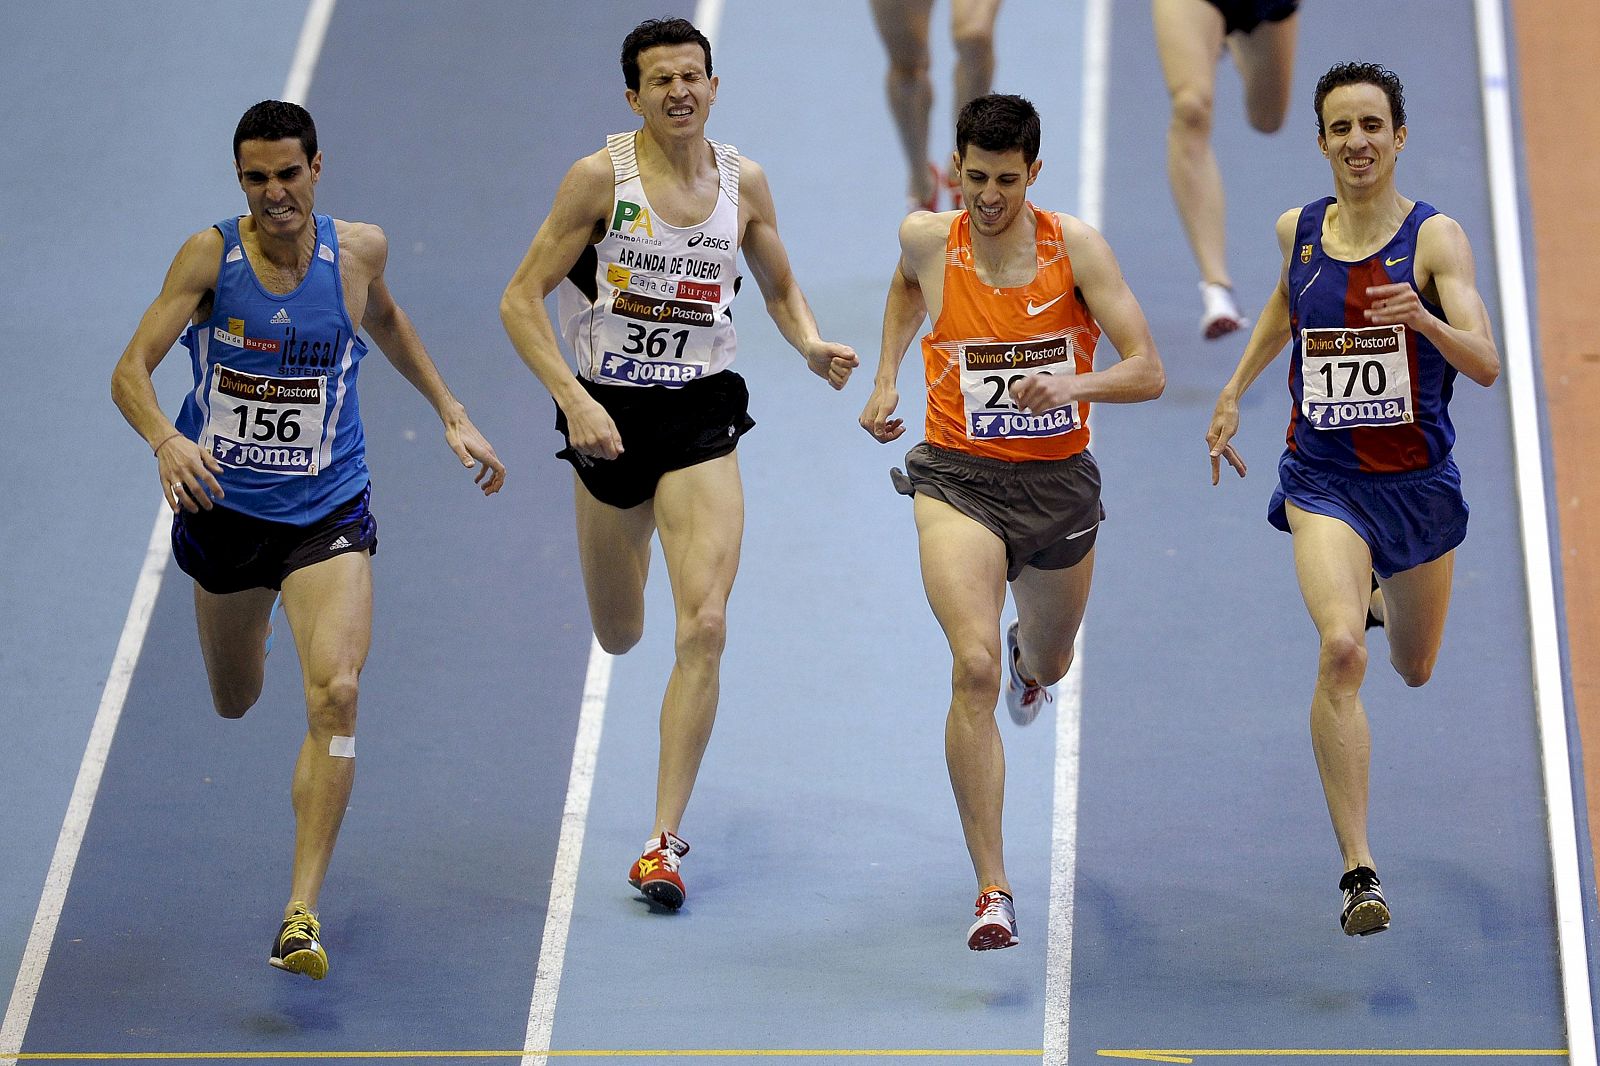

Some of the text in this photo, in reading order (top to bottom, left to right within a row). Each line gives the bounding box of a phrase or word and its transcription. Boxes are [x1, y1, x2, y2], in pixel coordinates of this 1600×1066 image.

[612, 200, 653, 238] PA
[609, 231, 662, 246] PromoAranda
[703, 236, 730, 250] asics
[619, 248, 721, 280] ARANDA DE DUERO
[630, 275, 719, 300] Caja de Burgos
[615, 297, 713, 321] Divina Pastora
[216, 330, 277, 351] Caja de Burgos
[281, 327, 340, 368] itesal
[622, 322, 690, 358] 361
[1355, 336, 1396, 348] Pastora
[967, 346, 1065, 364] Divina Pastora
[278, 367, 336, 377] SISTEMAS
[627, 361, 696, 382] Joma
[1320, 360, 1386, 397] 170
[221, 376, 318, 398] Divina Pastora
[232, 404, 301, 442] 156
[999, 409, 1070, 435] Joma
[1328, 400, 1402, 425] Joma
[235, 445, 309, 466] Joma
